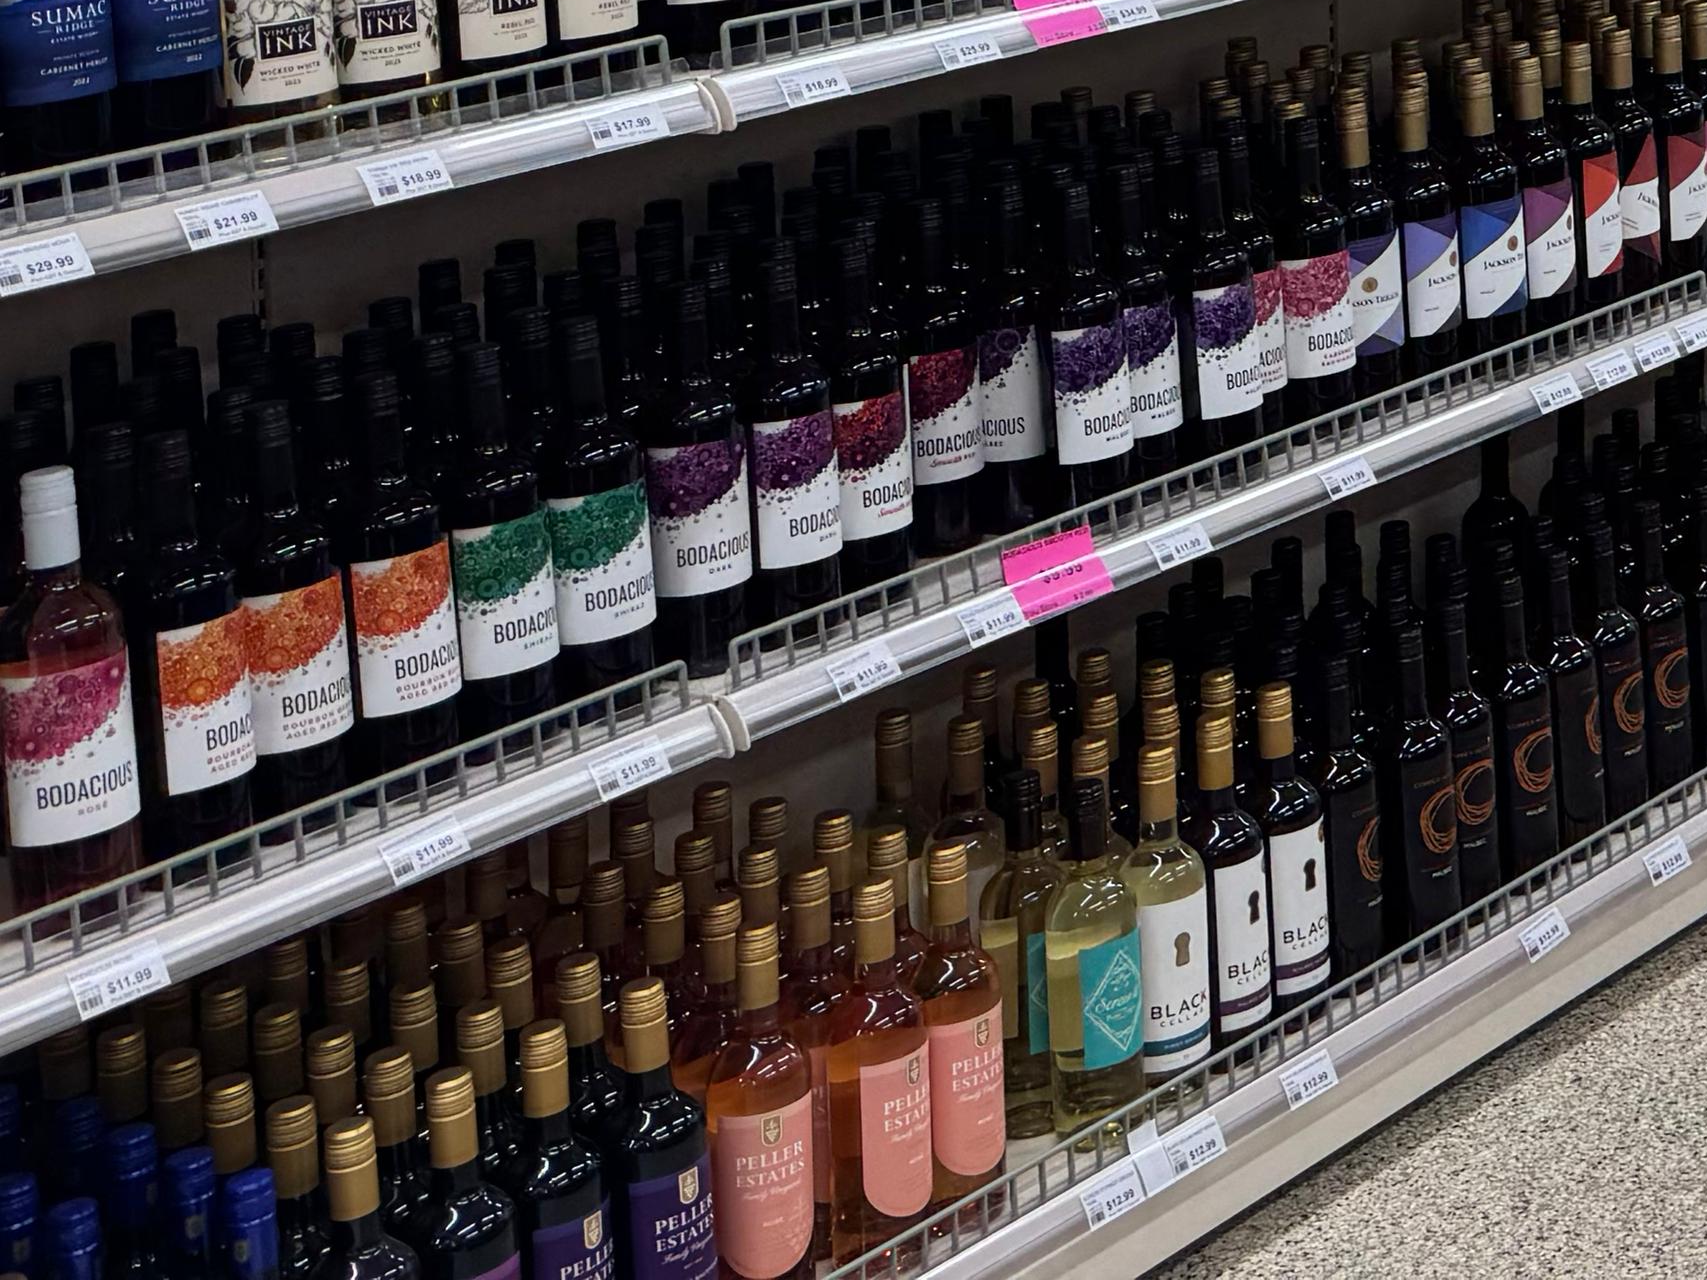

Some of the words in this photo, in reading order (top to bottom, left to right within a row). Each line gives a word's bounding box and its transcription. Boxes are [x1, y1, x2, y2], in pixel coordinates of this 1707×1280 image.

[31, 0, 107, 28] SUMAC
[170, 0, 206, 13] RIDGE
[364, 5, 414, 21] VINTAGE
[53, 19, 96, 34] RIDGE
[262, 22, 314, 38] VINTAGE
[363, 13, 413, 38] INK
[264, 32, 314, 55] INK
[401, 168, 443, 188] $18.99
[213, 210, 258, 230] $21.99
[26, 254, 75, 276] $29.99
[677, 532, 749, 567] BODACIOUS
[986, 612, 1015, 630] $11.99
[621, 756, 656, 780] $11.99
[37, 760, 133, 810] BODACIOUS
[414, 834, 454, 863] $11.99
[1283, 915, 1328, 944] BLACK
[1228, 950, 1269, 980] BLAC
[106, 967, 153, 995] $11.99
[1151, 989, 1207, 1021] BLACK
[952, 1047, 1003, 1076] PELLE
[1303, 1072, 1327, 1091] $12.99
[735, 1140, 803, 1171] PELLER
[1189, 1139, 1216, 1160] $12.99
[736, 1160, 804, 1189] ESTATES
[1107, 1189, 1134, 1210] $12.99
